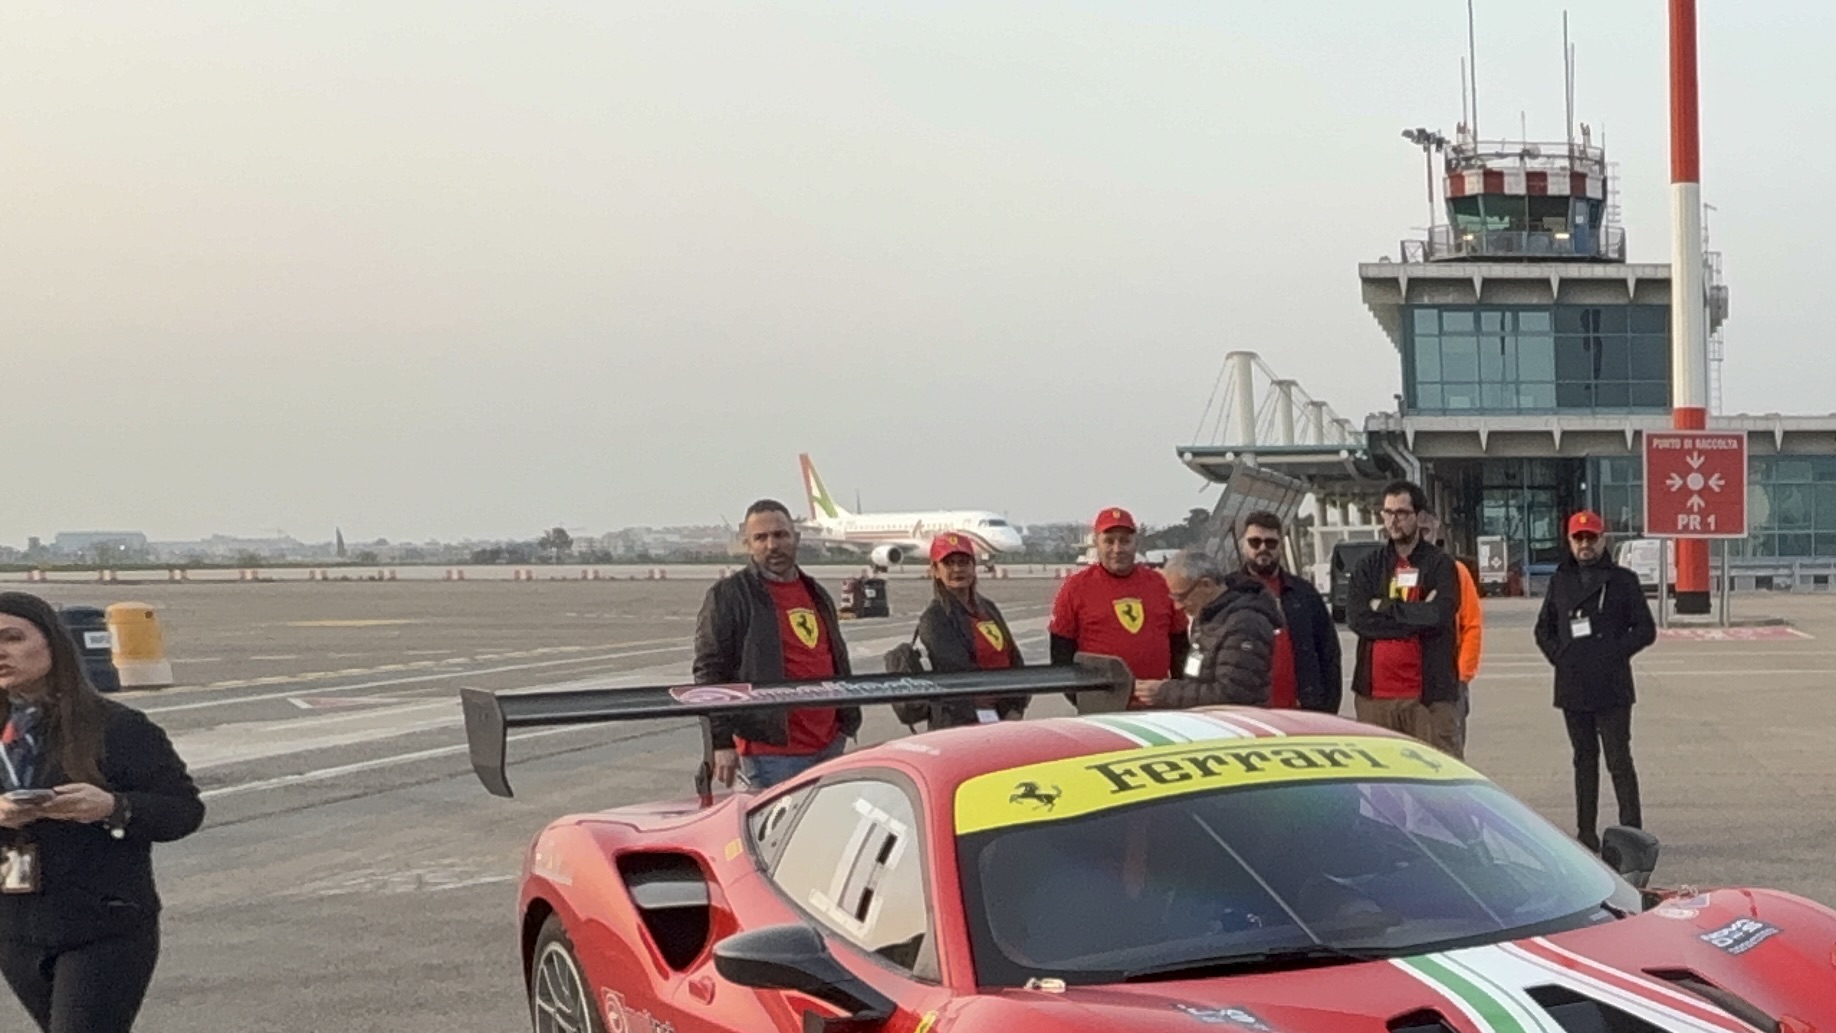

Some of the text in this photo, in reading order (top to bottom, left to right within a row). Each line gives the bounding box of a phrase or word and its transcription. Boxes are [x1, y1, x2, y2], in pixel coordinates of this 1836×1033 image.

[1652, 439, 1738, 449] PUNTO DI RACCOLTA
[1677, 514, 1716, 531] PR 1
[1084, 742, 1390, 794] Ferrari
